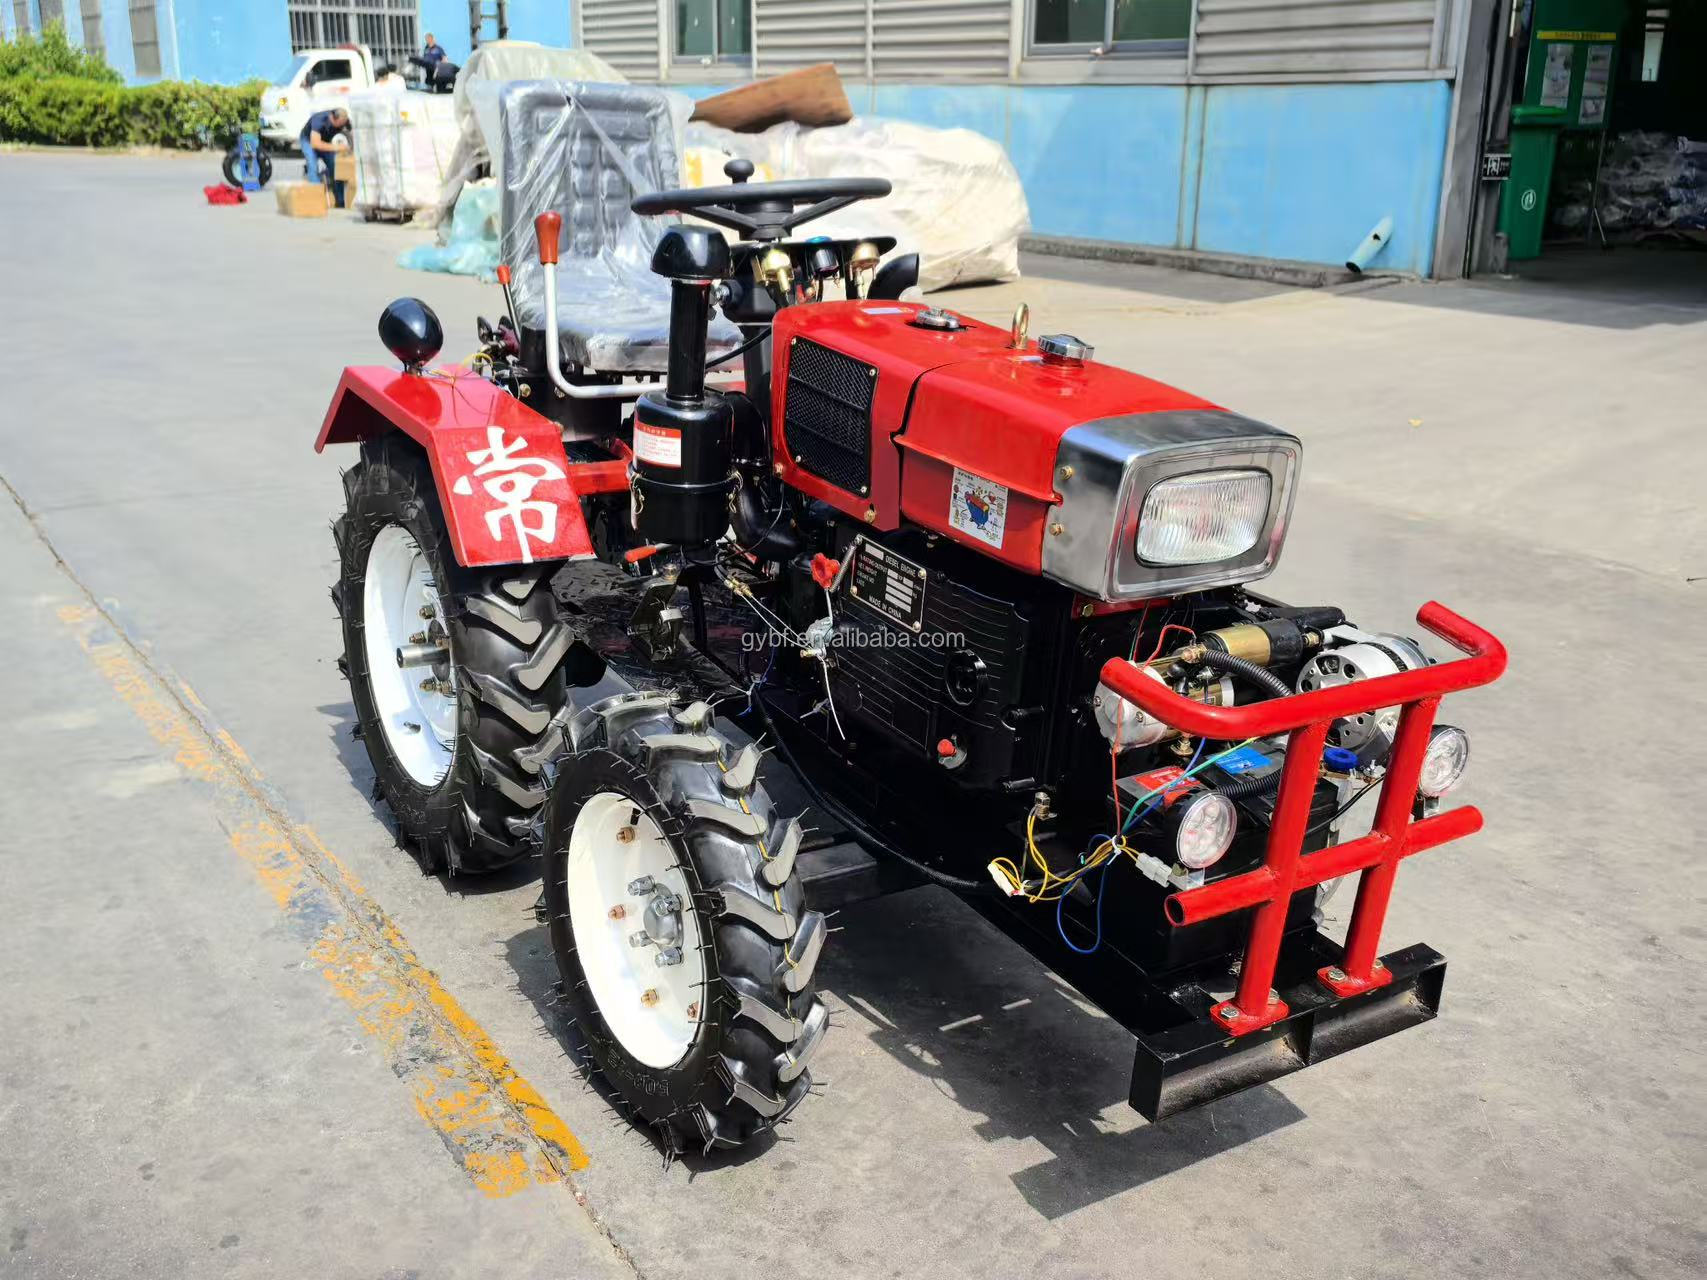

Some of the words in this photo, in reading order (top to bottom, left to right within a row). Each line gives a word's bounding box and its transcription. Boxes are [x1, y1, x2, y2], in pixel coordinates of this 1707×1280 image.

[453, 426, 566, 563] 常
[868, 595, 882, 608] MADE
[881, 603, 888, 612] IN
[888, 605, 902, 620] CHINA
